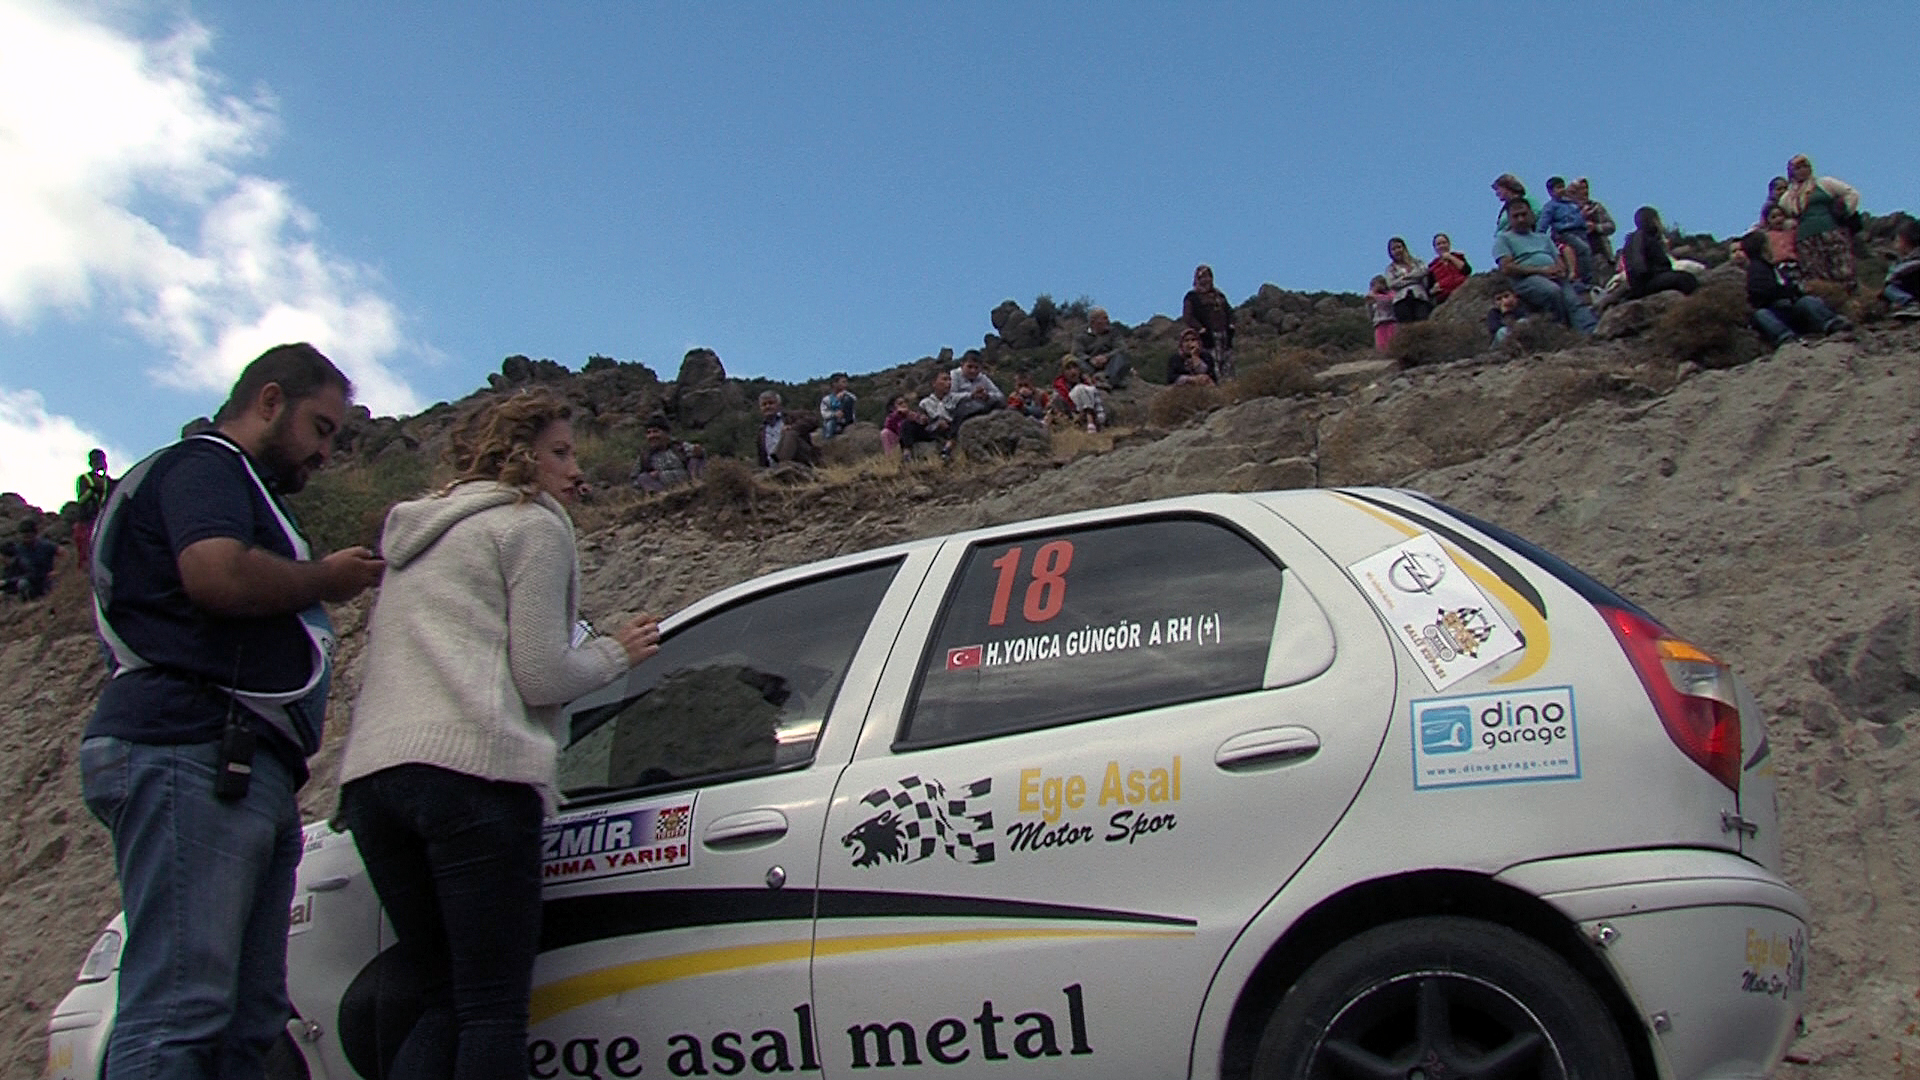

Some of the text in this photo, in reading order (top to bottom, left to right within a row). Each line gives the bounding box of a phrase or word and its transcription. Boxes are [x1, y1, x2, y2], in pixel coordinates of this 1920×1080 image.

[988, 540, 1075, 626] 18
[986, 634, 1060, 666] H.YONCA
[1066, 619, 1141, 655] GÜNGÖR
[1149, 620, 1162, 645] A
[1167, 616, 1193, 643] RH
[1481, 701, 1564, 728] dino
[1482, 726, 1567, 749] garage
[1426, 759, 1568, 776] www.dinogarage.com
[1018, 755, 1182, 823] Ege Asal
[542, 818, 633, 859] ZMİR
[1006, 810, 1177, 851] Motor Spor
[605, 844, 687, 867] YARIŞI
[667, 1003, 821, 1077] asal
[847, 983, 1093, 1069] metal
